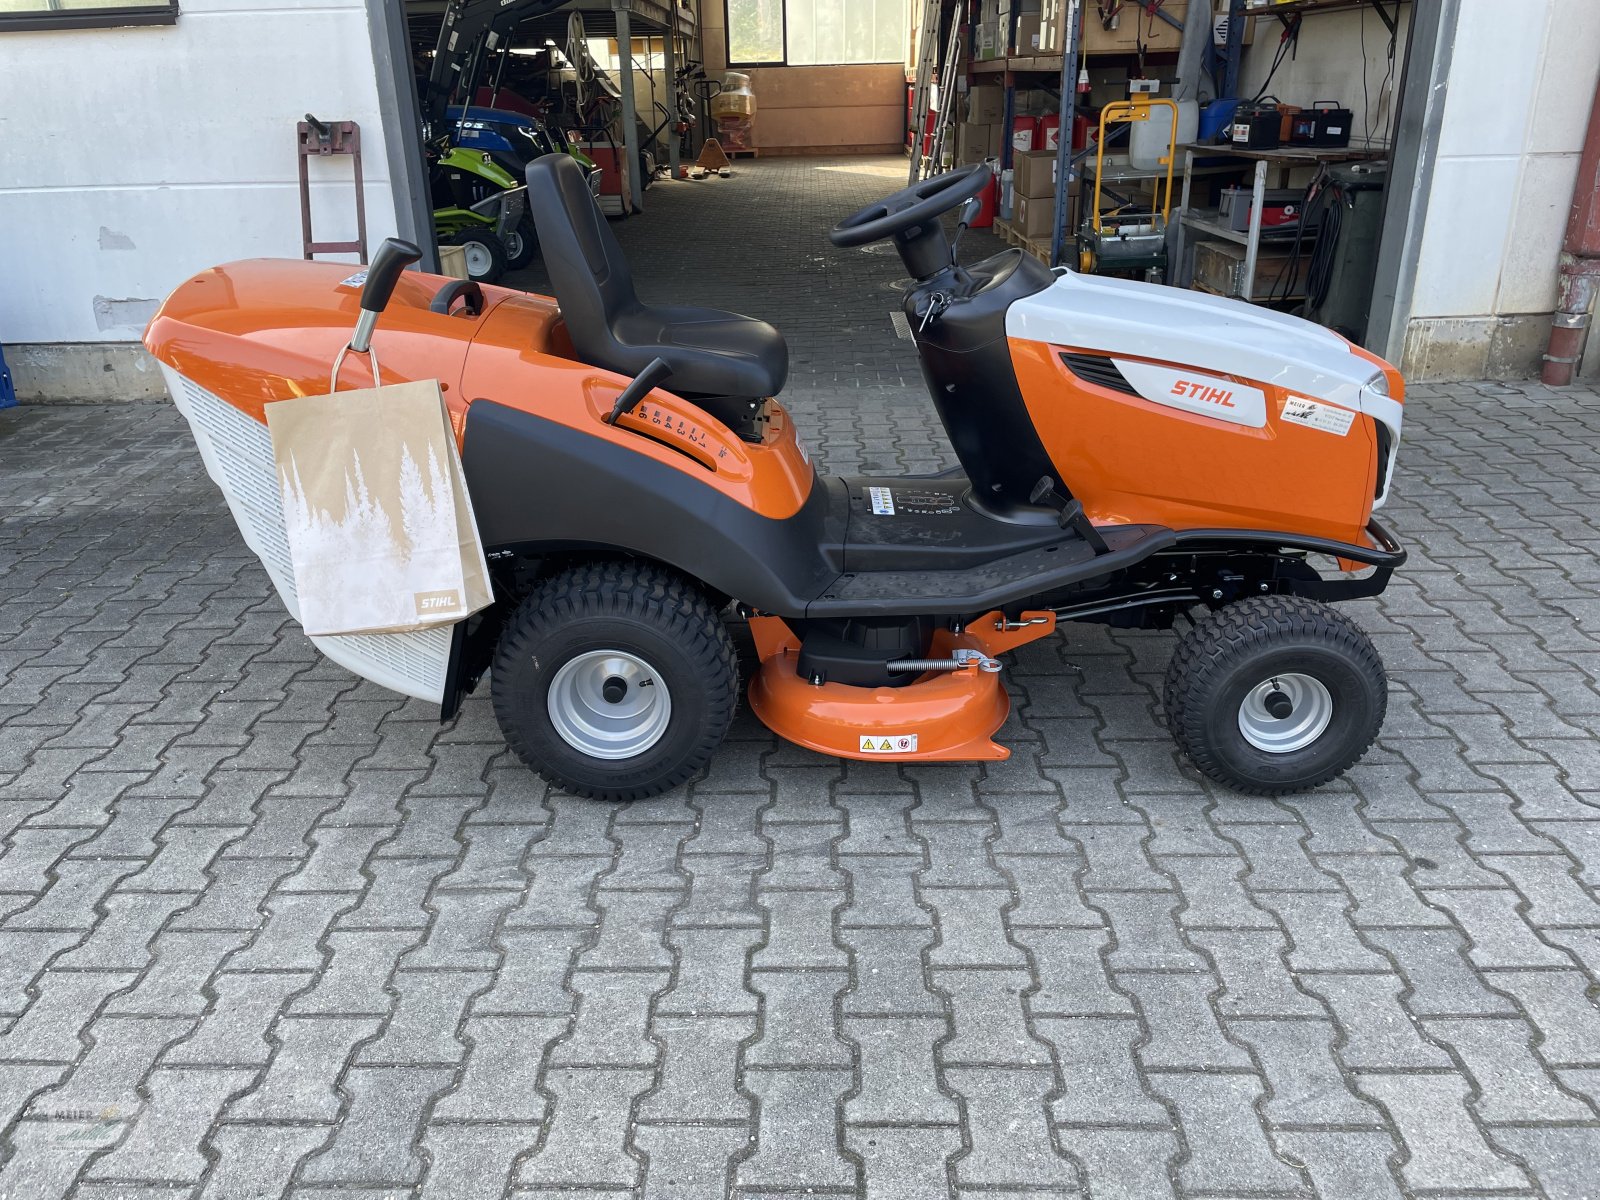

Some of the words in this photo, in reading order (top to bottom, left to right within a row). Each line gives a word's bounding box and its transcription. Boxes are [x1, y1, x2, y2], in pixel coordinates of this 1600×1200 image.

[1170, 379, 1236, 408] STIHL
[652, 417, 661, 425] 5
[664, 422, 673, 430] 4
[676, 428, 686, 436] 3
[688, 434, 698, 442] 2
[420, 596, 456, 609] STIHL
